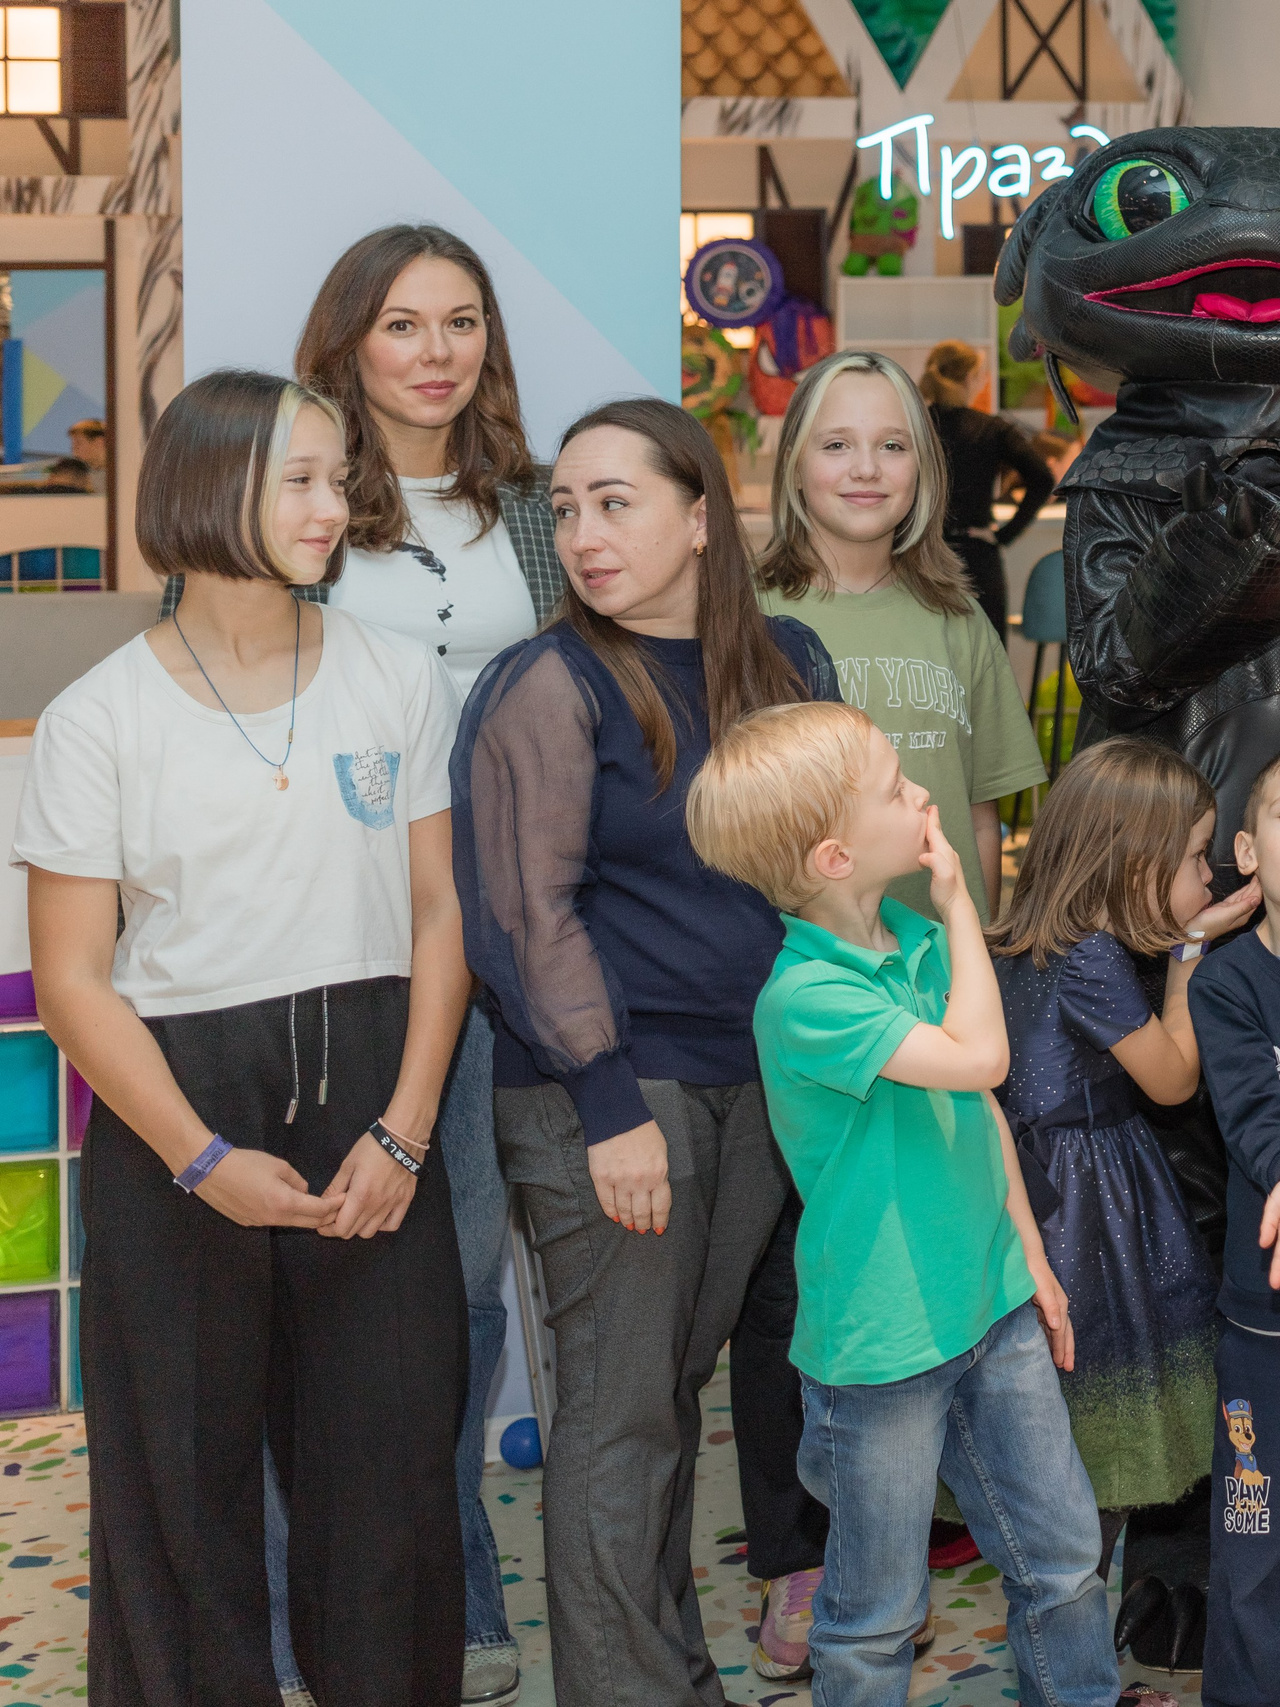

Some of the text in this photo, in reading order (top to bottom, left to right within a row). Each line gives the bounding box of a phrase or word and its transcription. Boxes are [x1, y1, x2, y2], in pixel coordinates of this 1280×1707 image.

[876, 657, 972, 734] YORK
[1225, 1476, 1270, 1506] PAW
[1224, 1507, 1270, 1533] SOME
